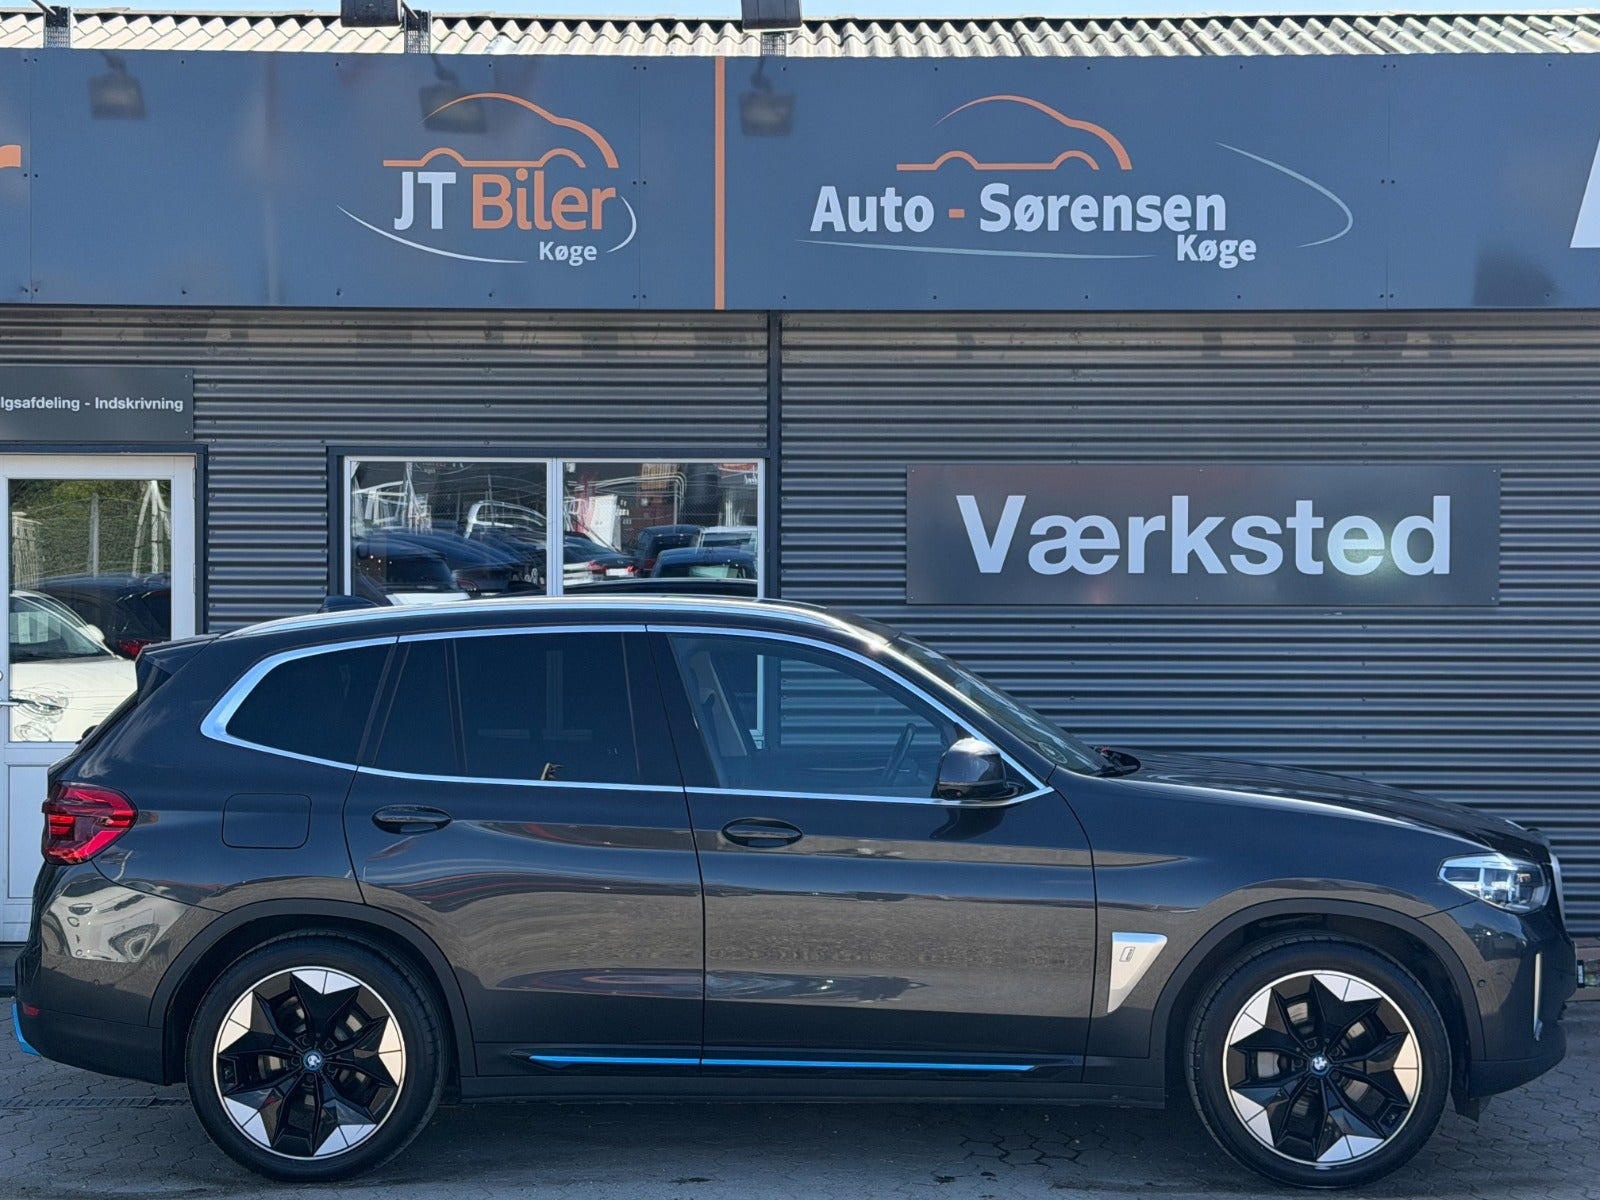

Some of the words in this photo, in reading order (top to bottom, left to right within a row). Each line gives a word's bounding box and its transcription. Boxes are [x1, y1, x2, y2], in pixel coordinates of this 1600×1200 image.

[394, 171, 457, 231] JT
[473, 168, 616, 231] Biler
[811, 186, 935, 233] Auto
[949, 208, 965, 218] -
[979, 182, 1226, 233] Sørensen
[538, 241, 597, 267] Køge
[1177, 234, 1257, 270] Køge
[95, 397, 184, 412] Indskrivning
[955, 495, 1451, 576] Værksted
